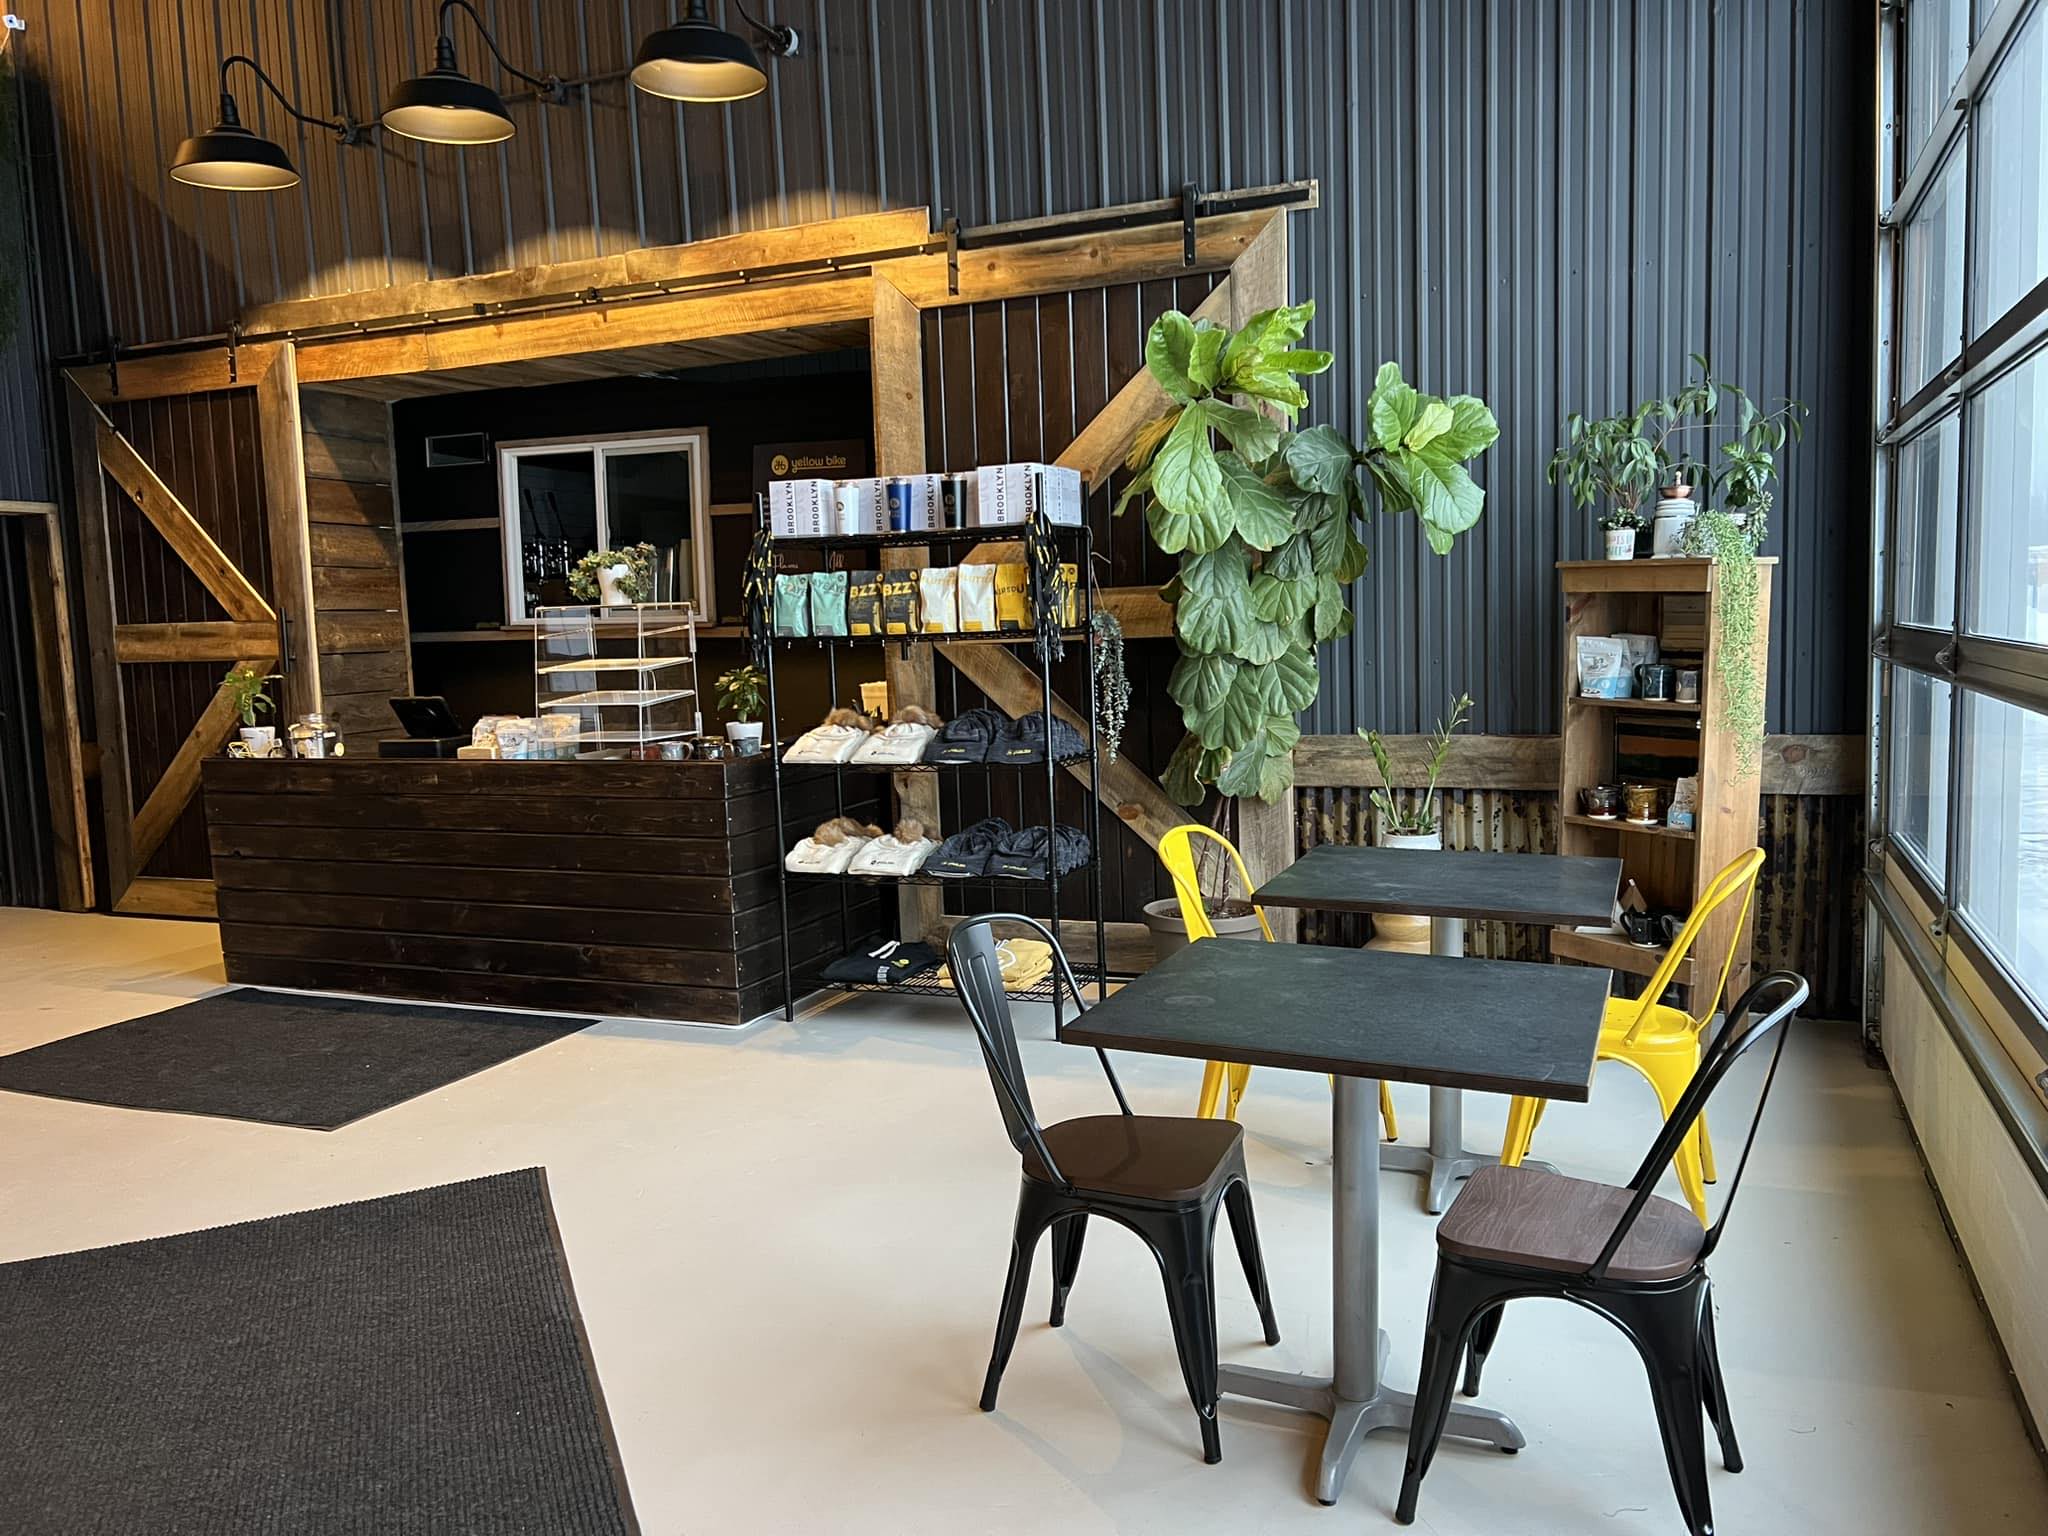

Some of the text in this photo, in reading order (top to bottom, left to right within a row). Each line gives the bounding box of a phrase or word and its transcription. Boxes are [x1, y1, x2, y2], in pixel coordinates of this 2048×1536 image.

[791, 455, 847, 473] yellow bike
[785, 482, 795, 533] BROOKLYN
[811, 480, 820, 533] BROOKLYN
[874, 479, 884, 531] BROOKLYN
[926, 475, 936, 528] BROOKLYN
[996, 467, 1005, 522] BROOKLYN
